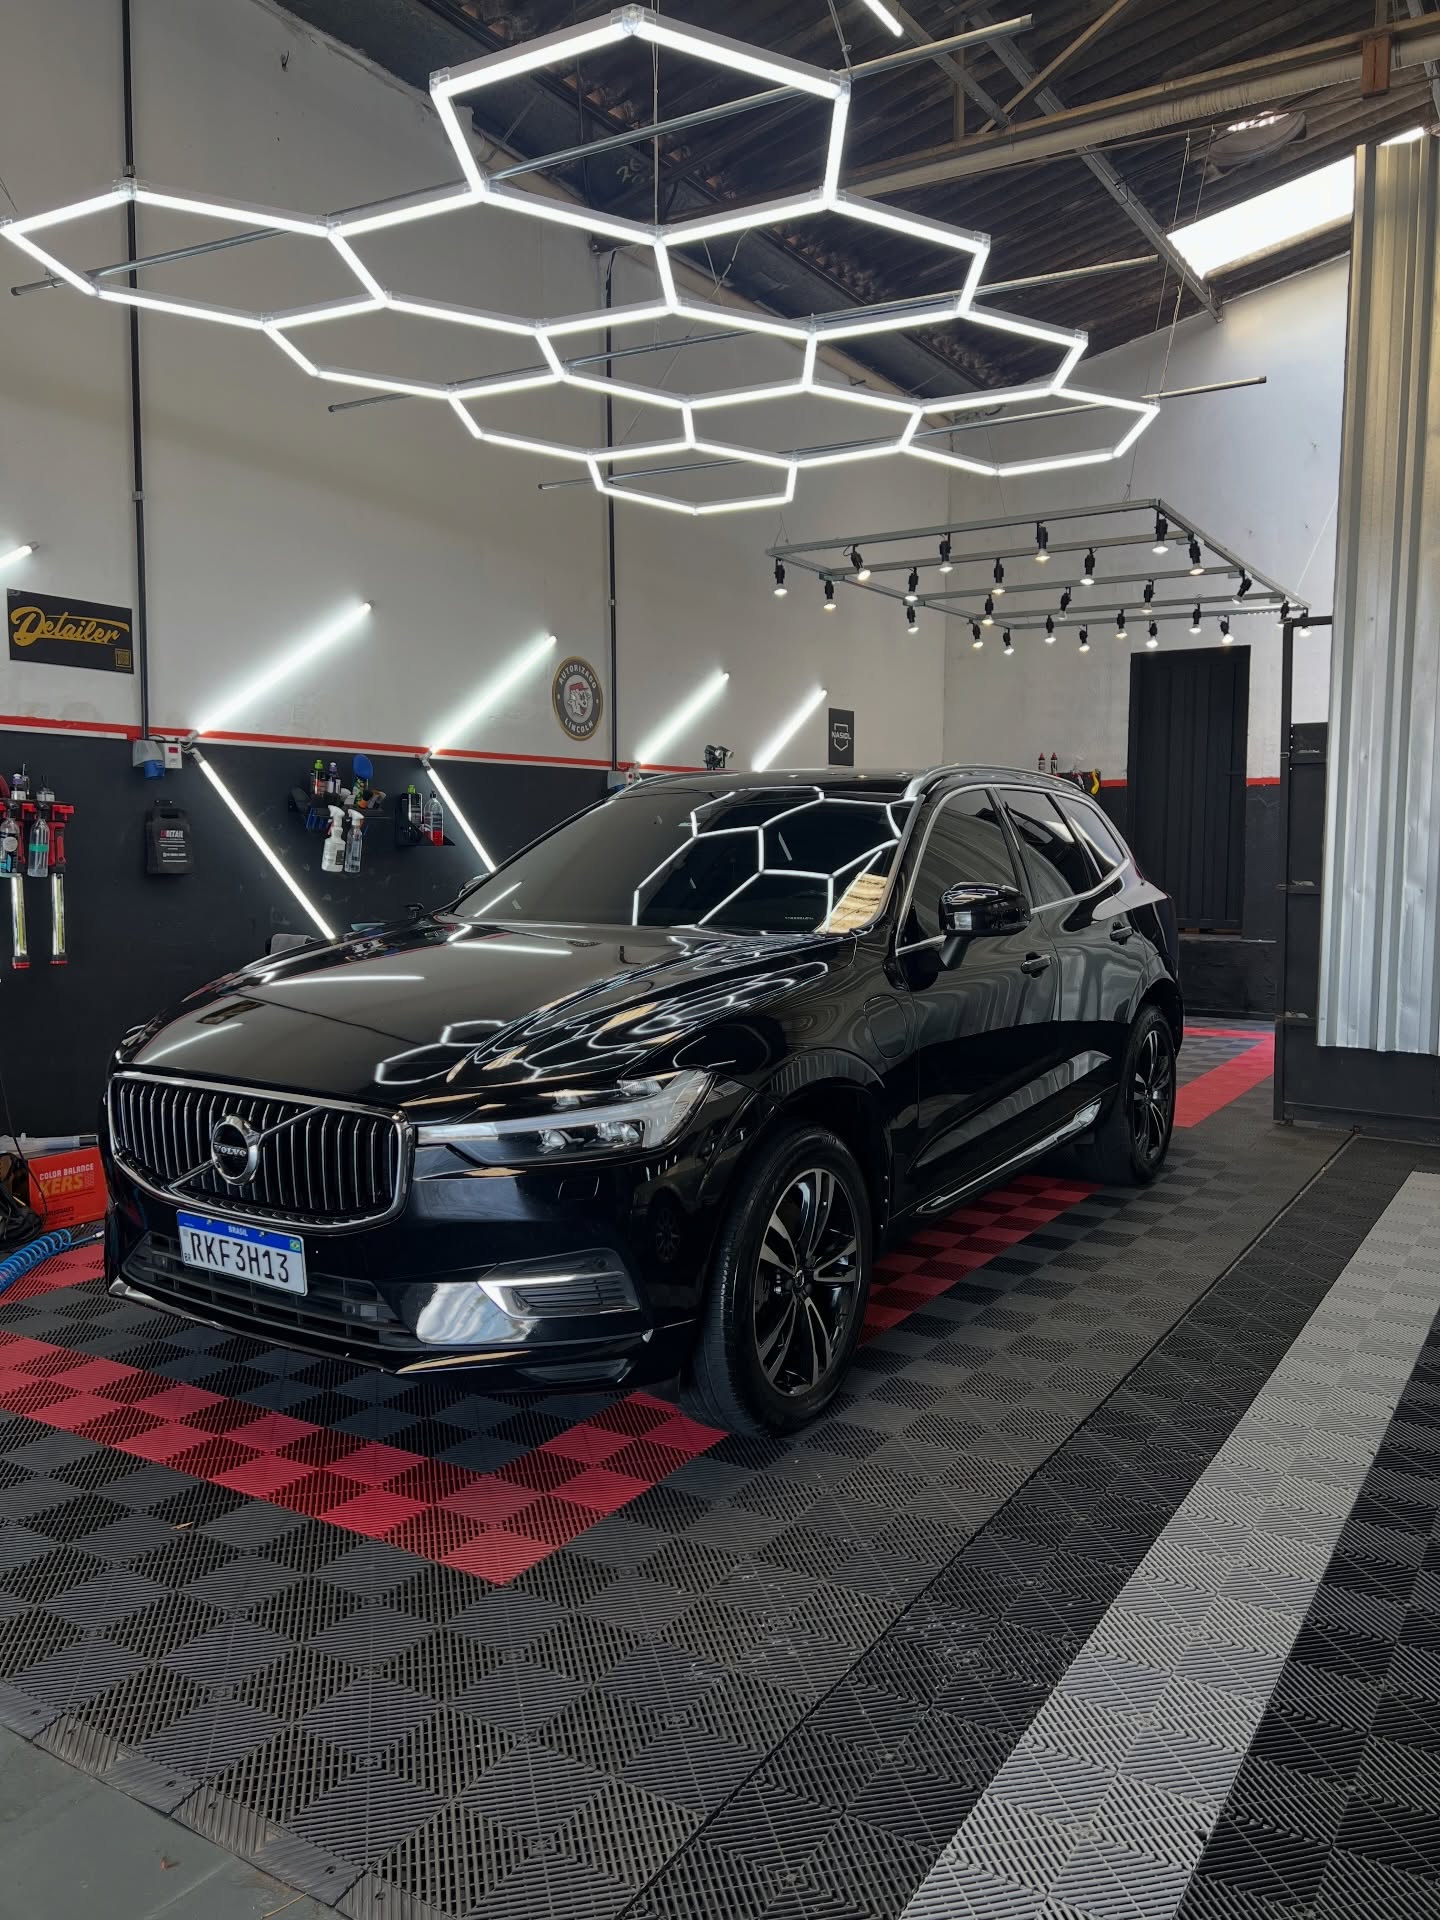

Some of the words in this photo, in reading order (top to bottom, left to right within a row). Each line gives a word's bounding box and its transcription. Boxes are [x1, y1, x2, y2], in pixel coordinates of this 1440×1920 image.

[11, 606, 129, 647] Detailer
[559, 664, 597, 689] AUTORIZADO
[564, 718, 594, 733] LINCOLN
[213, 1143, 247, 1157] VOLVO
[40, 1170, 62, 1181] COLOR
[63, 1163, 94, 1176] BALANCE
[39, 1174, 83, 1198] KERS
[228, 1225, 248, 1237] BRASIL
[190, 1233, 289, 1283] RKF3H13
